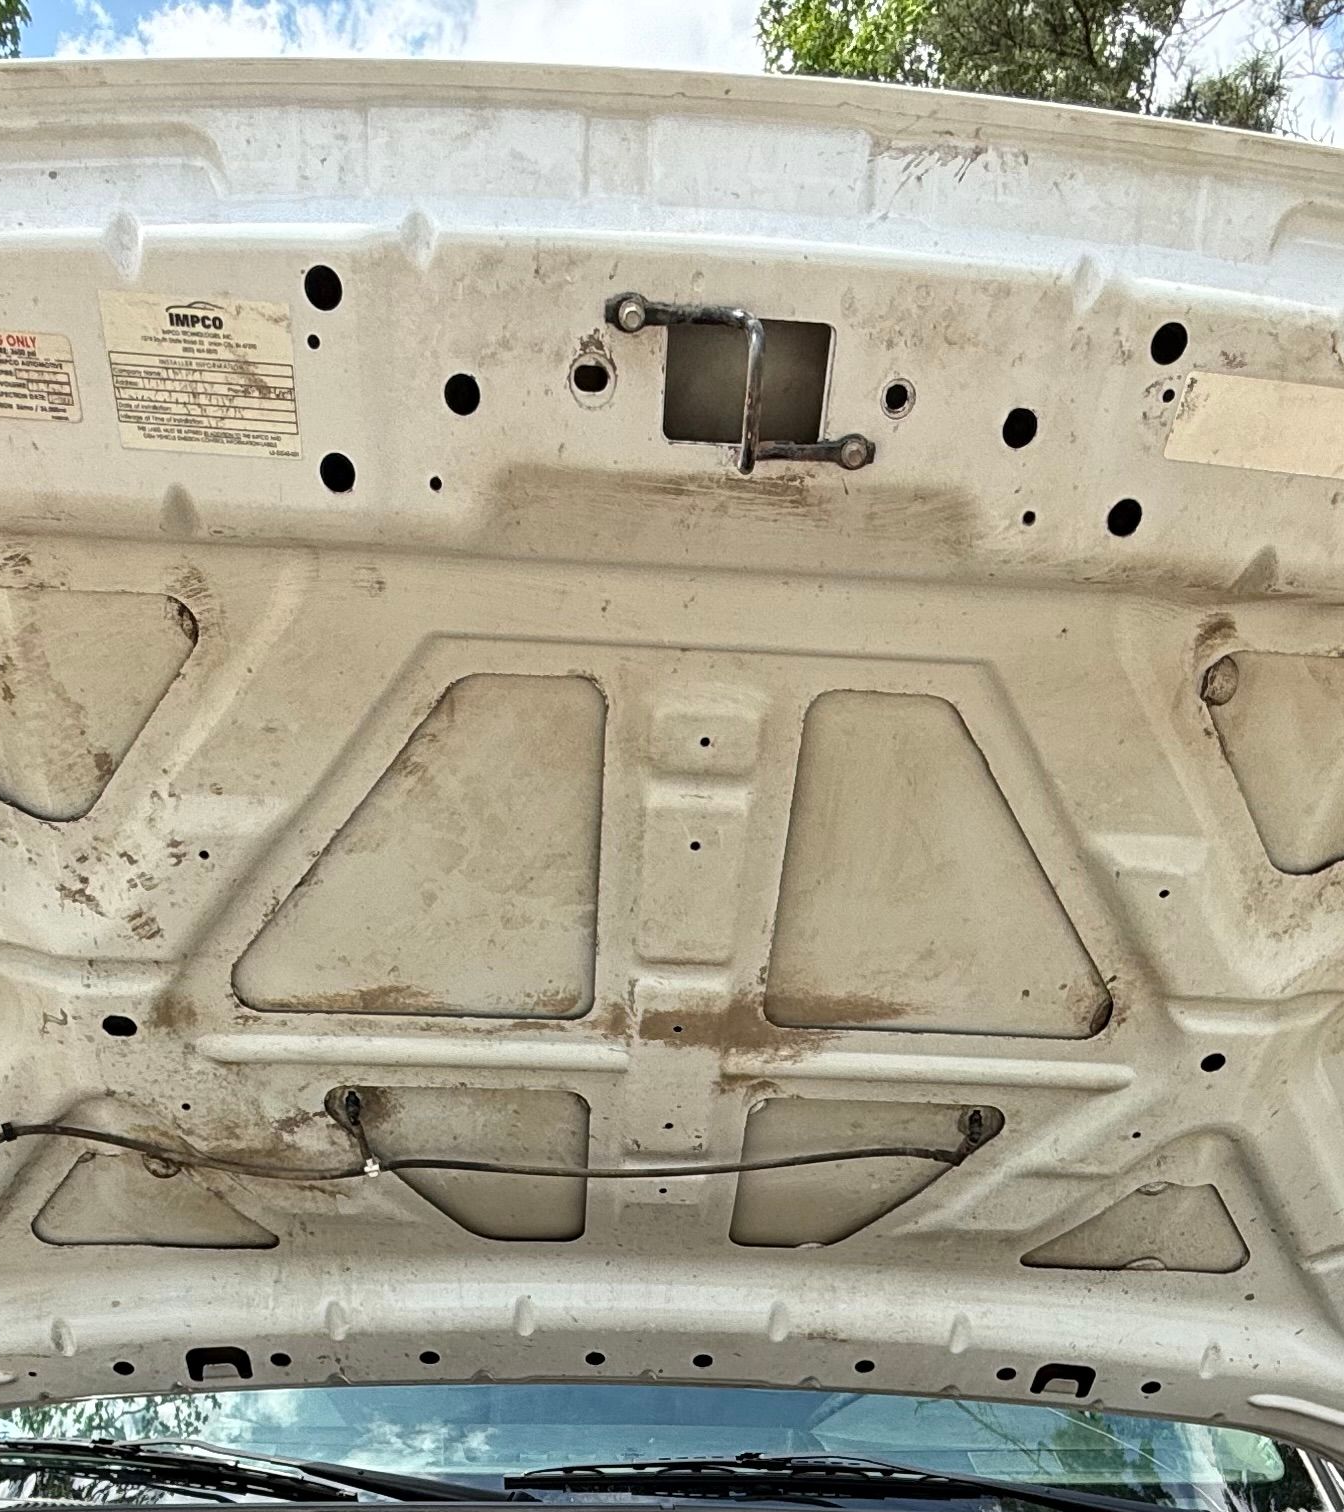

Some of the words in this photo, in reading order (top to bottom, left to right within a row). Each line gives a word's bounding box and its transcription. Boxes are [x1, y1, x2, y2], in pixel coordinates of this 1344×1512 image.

[168, 312, 224, 329] IMPCO
[6, 334, 36, 349] ONLY
[158, 358, 193, 368] INSTALLER
